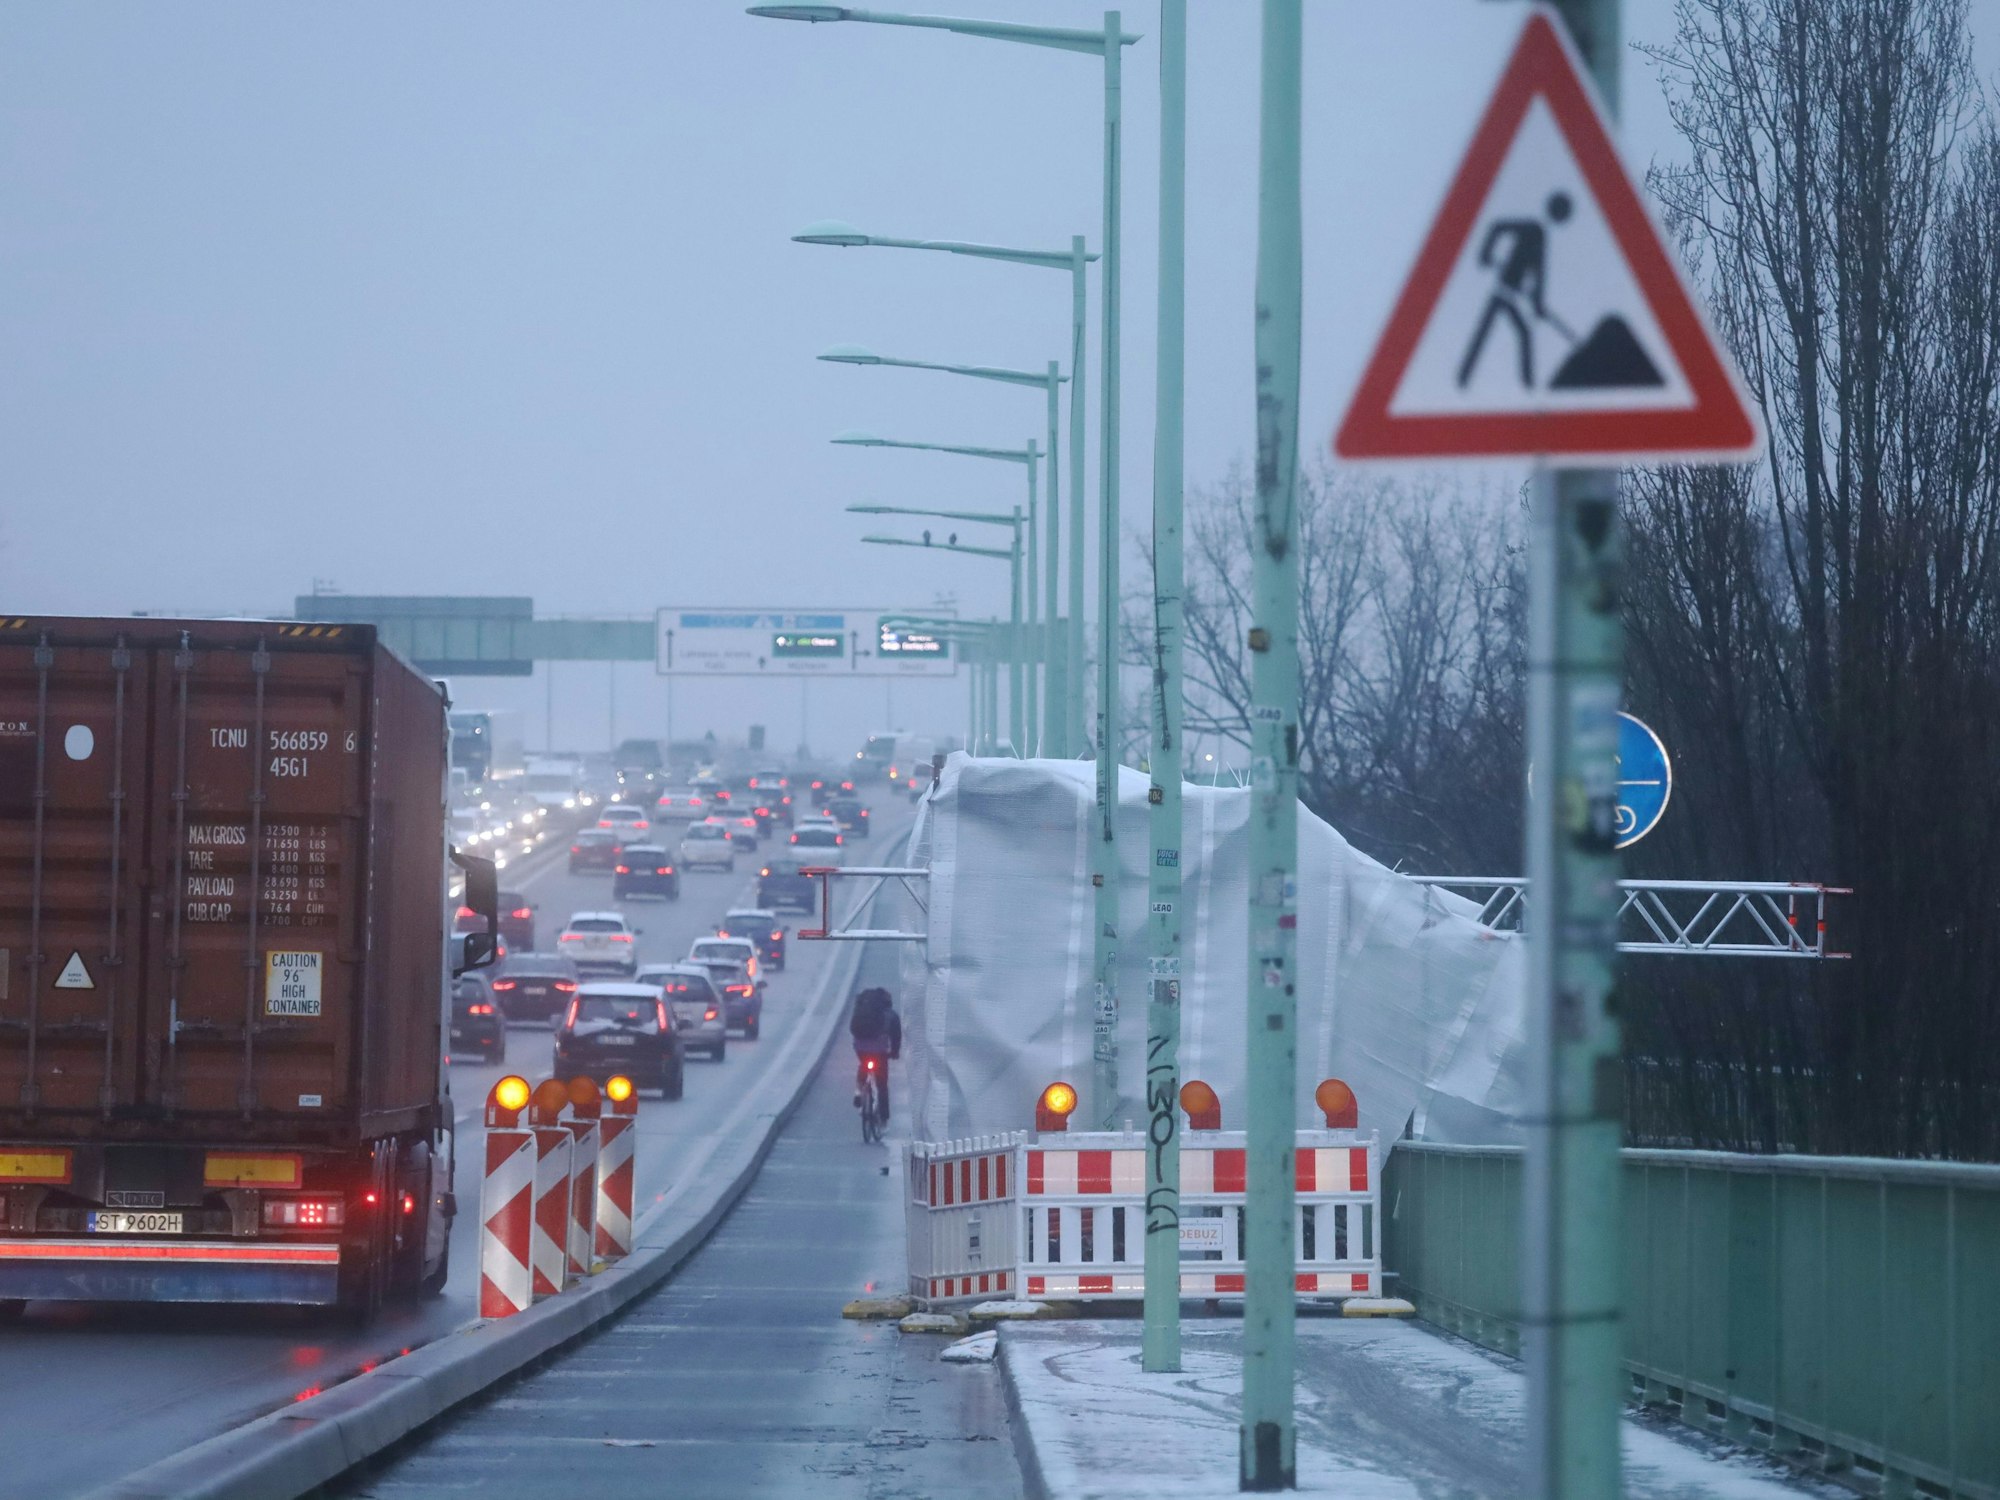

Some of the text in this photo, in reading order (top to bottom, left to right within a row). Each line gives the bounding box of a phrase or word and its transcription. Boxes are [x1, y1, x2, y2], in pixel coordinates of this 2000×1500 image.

[210, 728, 355, 751] TCNU 566859 6
[270, 757, 308, 777] 45G1
[189, 825, 212, 844] MAX
[213, 826, 246, 845] GROSS
[266, 839, 299, 849] 71.650
[188, 851, 326, 870] TARE 3.810 KGS
[187, 877, 234, 896] PAYLOAD
[308, 878, 326, 889] KGS
[264, 890, 298, 900] 63.250
[272, 953, 317, 967] CAUTION
[281, 984, 306, 998] HIGH
[266, 999, 320, 1014] CONTAINER
[100, 1214, 120, 1230] ST
[127, 1214, 178, 1231] 9602H
